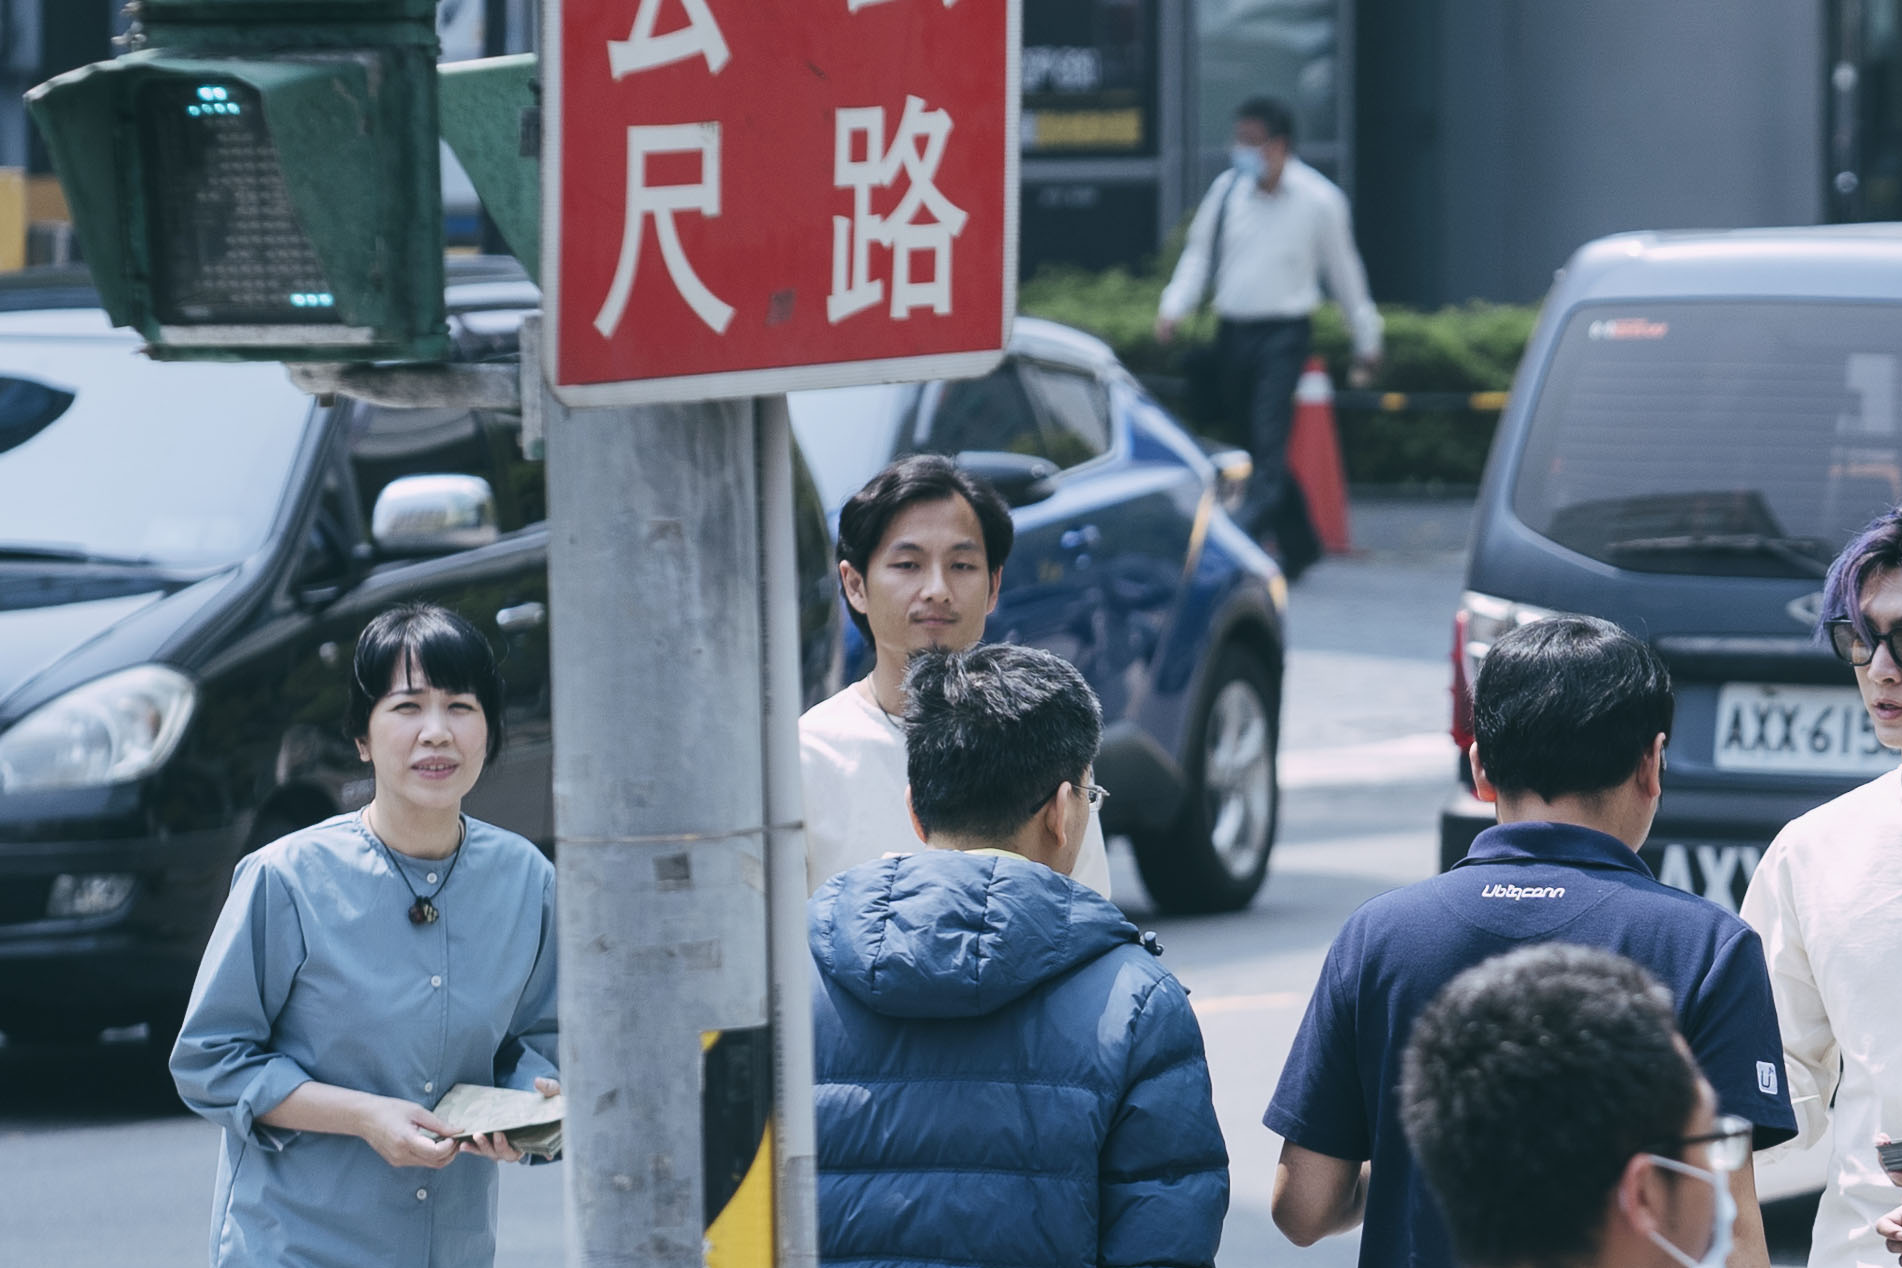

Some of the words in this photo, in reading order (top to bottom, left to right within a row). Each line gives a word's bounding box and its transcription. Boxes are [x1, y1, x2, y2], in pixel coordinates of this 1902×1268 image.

[827, 0, 969, 324] 路
[1481, 884, 1566, 901] Ubiqconn
[1658, 843, 1760, 916] AX
